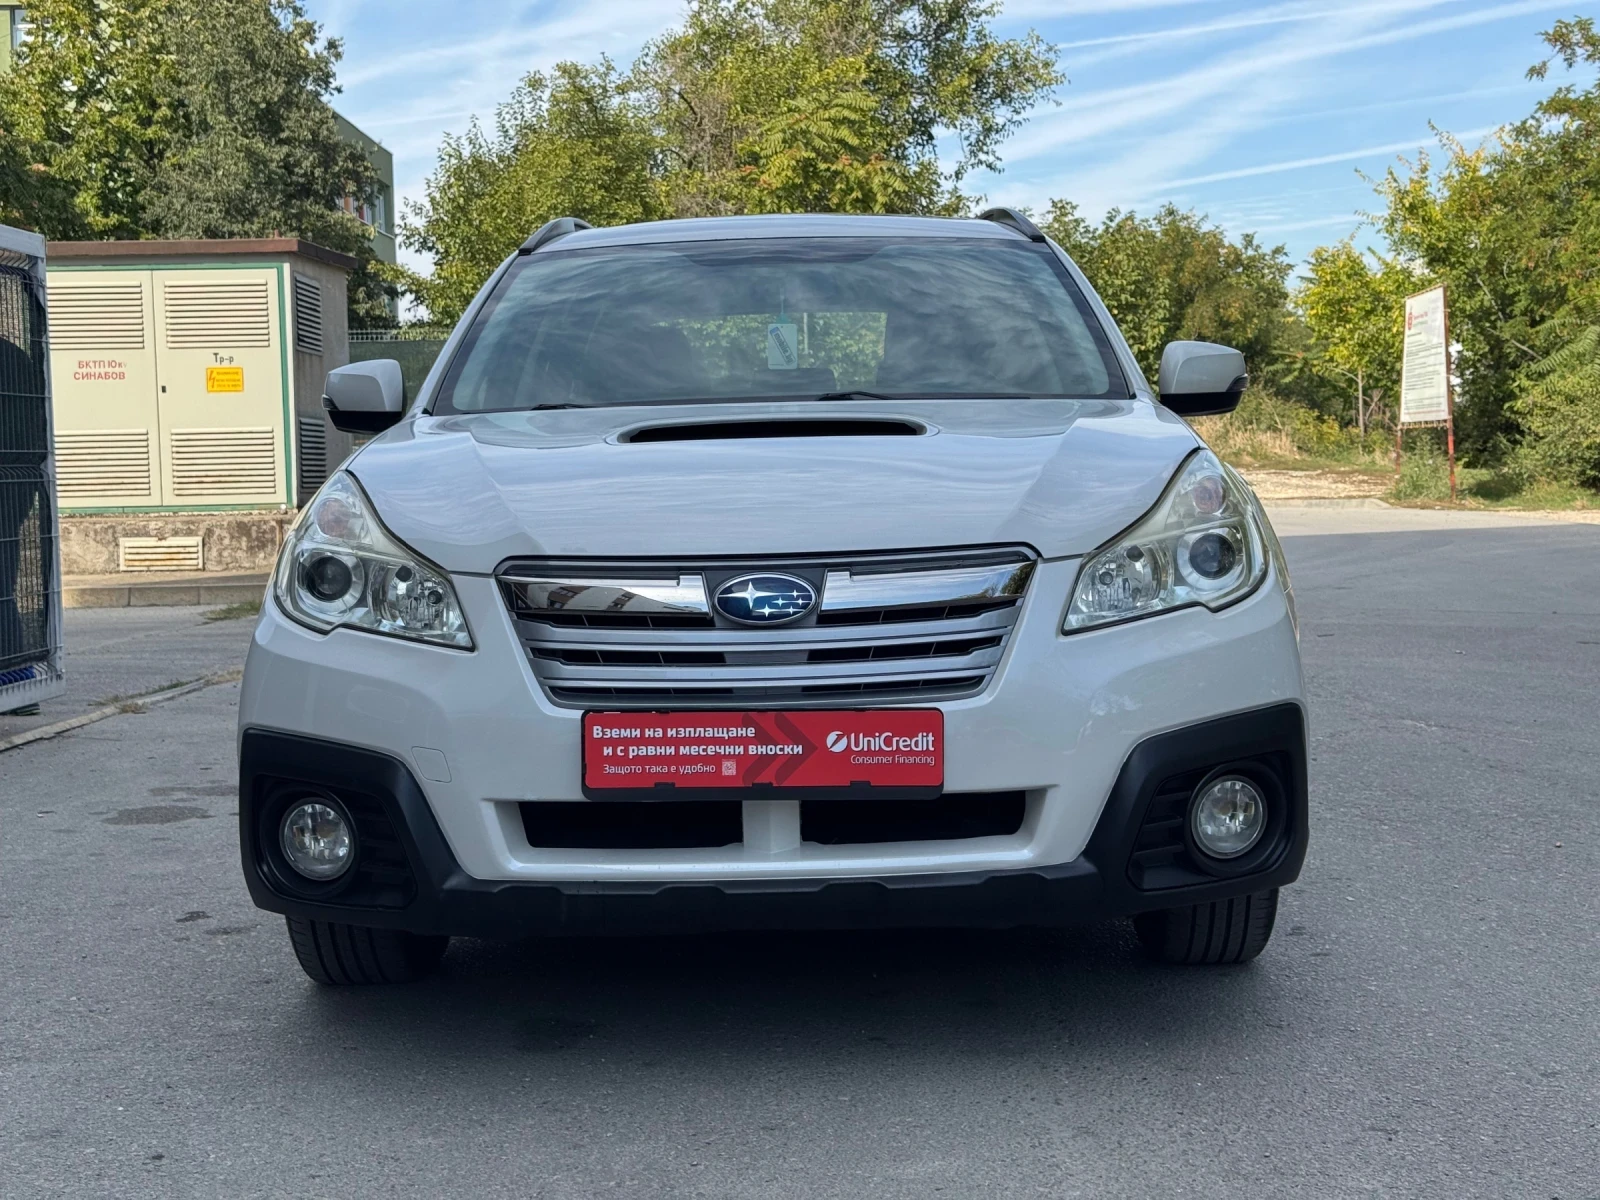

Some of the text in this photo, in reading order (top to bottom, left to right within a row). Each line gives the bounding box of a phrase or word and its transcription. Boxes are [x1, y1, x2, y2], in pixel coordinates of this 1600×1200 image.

[78, 360, 106, 369] БКТП
[73, 371, 126, 381] СИНАБОВ
[592, 725, 756, 740] Вземи на изплащане
[850, 731, 935, 752] UniCredit
[603, 744, 803, 759] и с равни месечни вноски
[850, 753, 935, 766] Consumer Financing
[602, 763, 716, 775] Защото така е удобно
